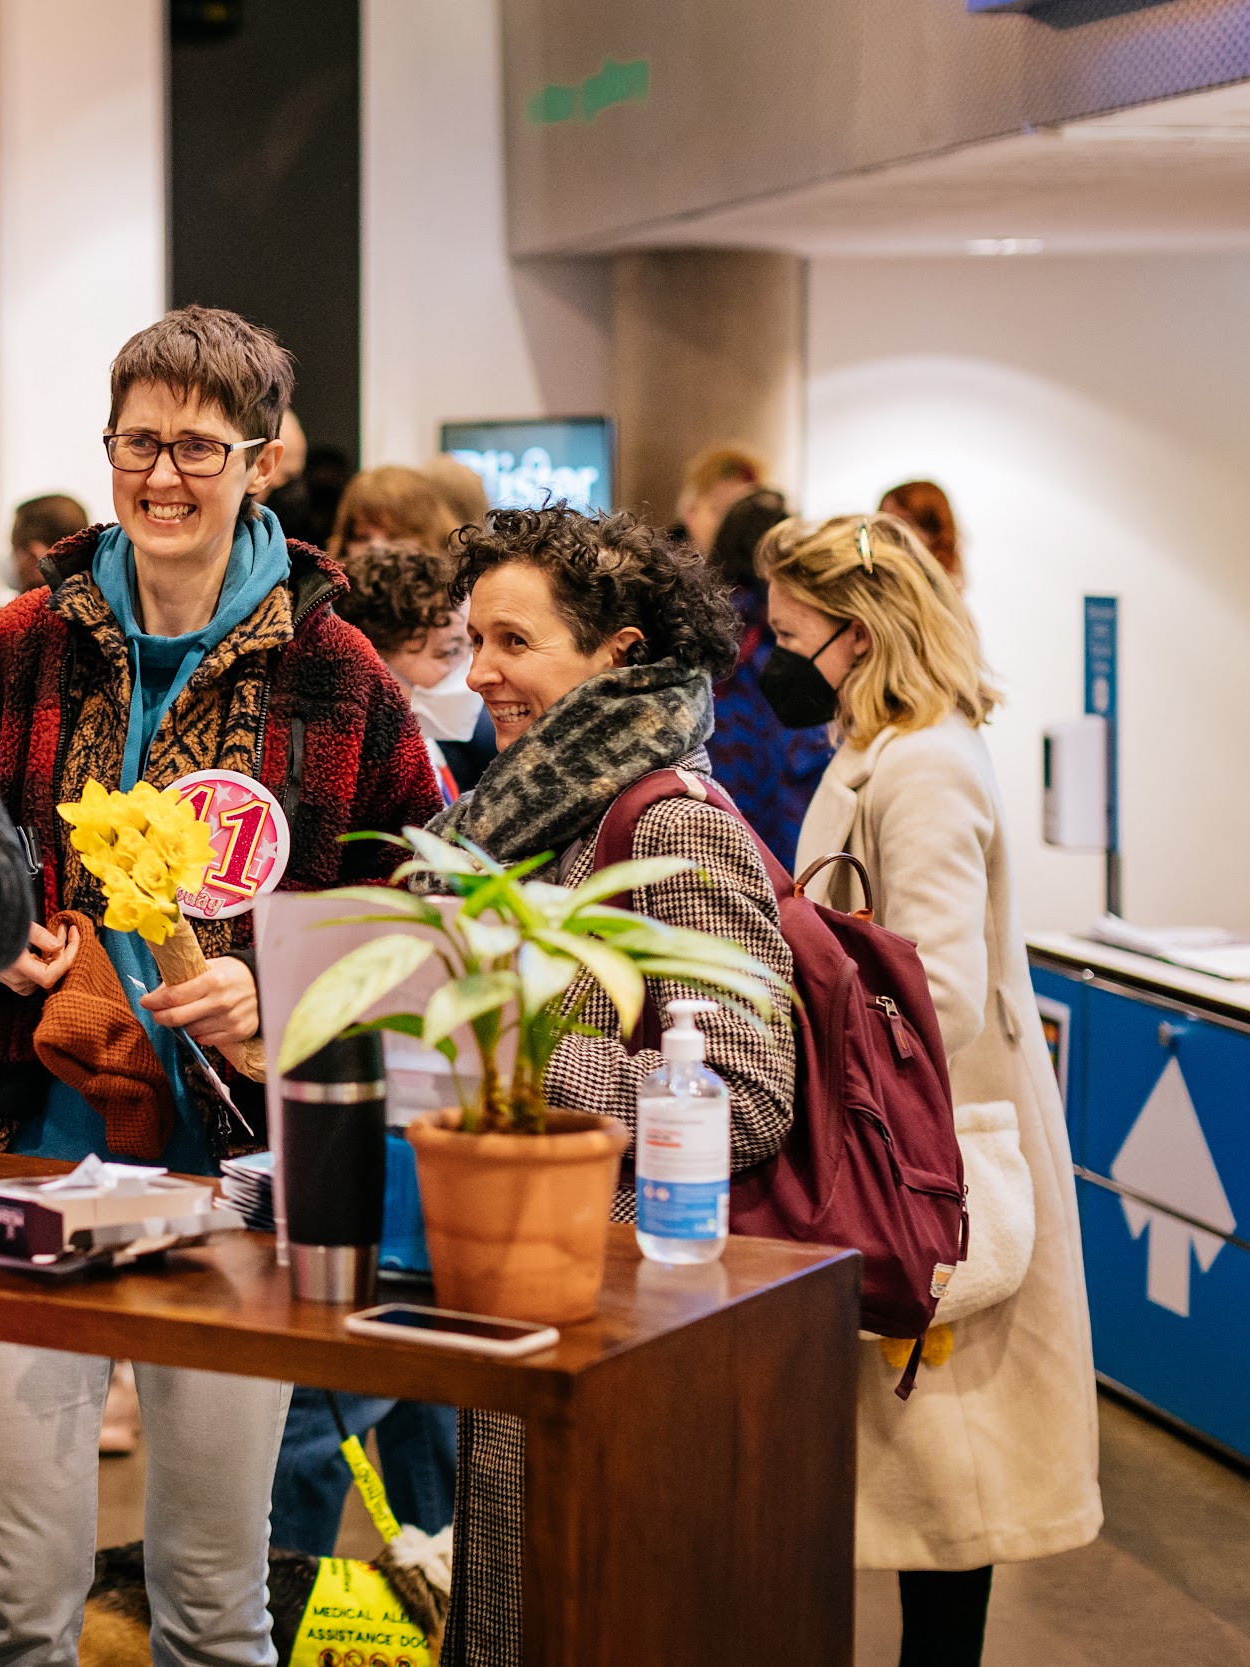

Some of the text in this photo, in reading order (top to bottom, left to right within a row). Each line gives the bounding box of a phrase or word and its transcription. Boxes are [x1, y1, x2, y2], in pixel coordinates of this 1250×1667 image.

[176, 886, 225, 917] oday
[313, 1606, 414, 1624] MEDICAL ALE
[307, 1628, 391, 1646] ASSISTANCE
